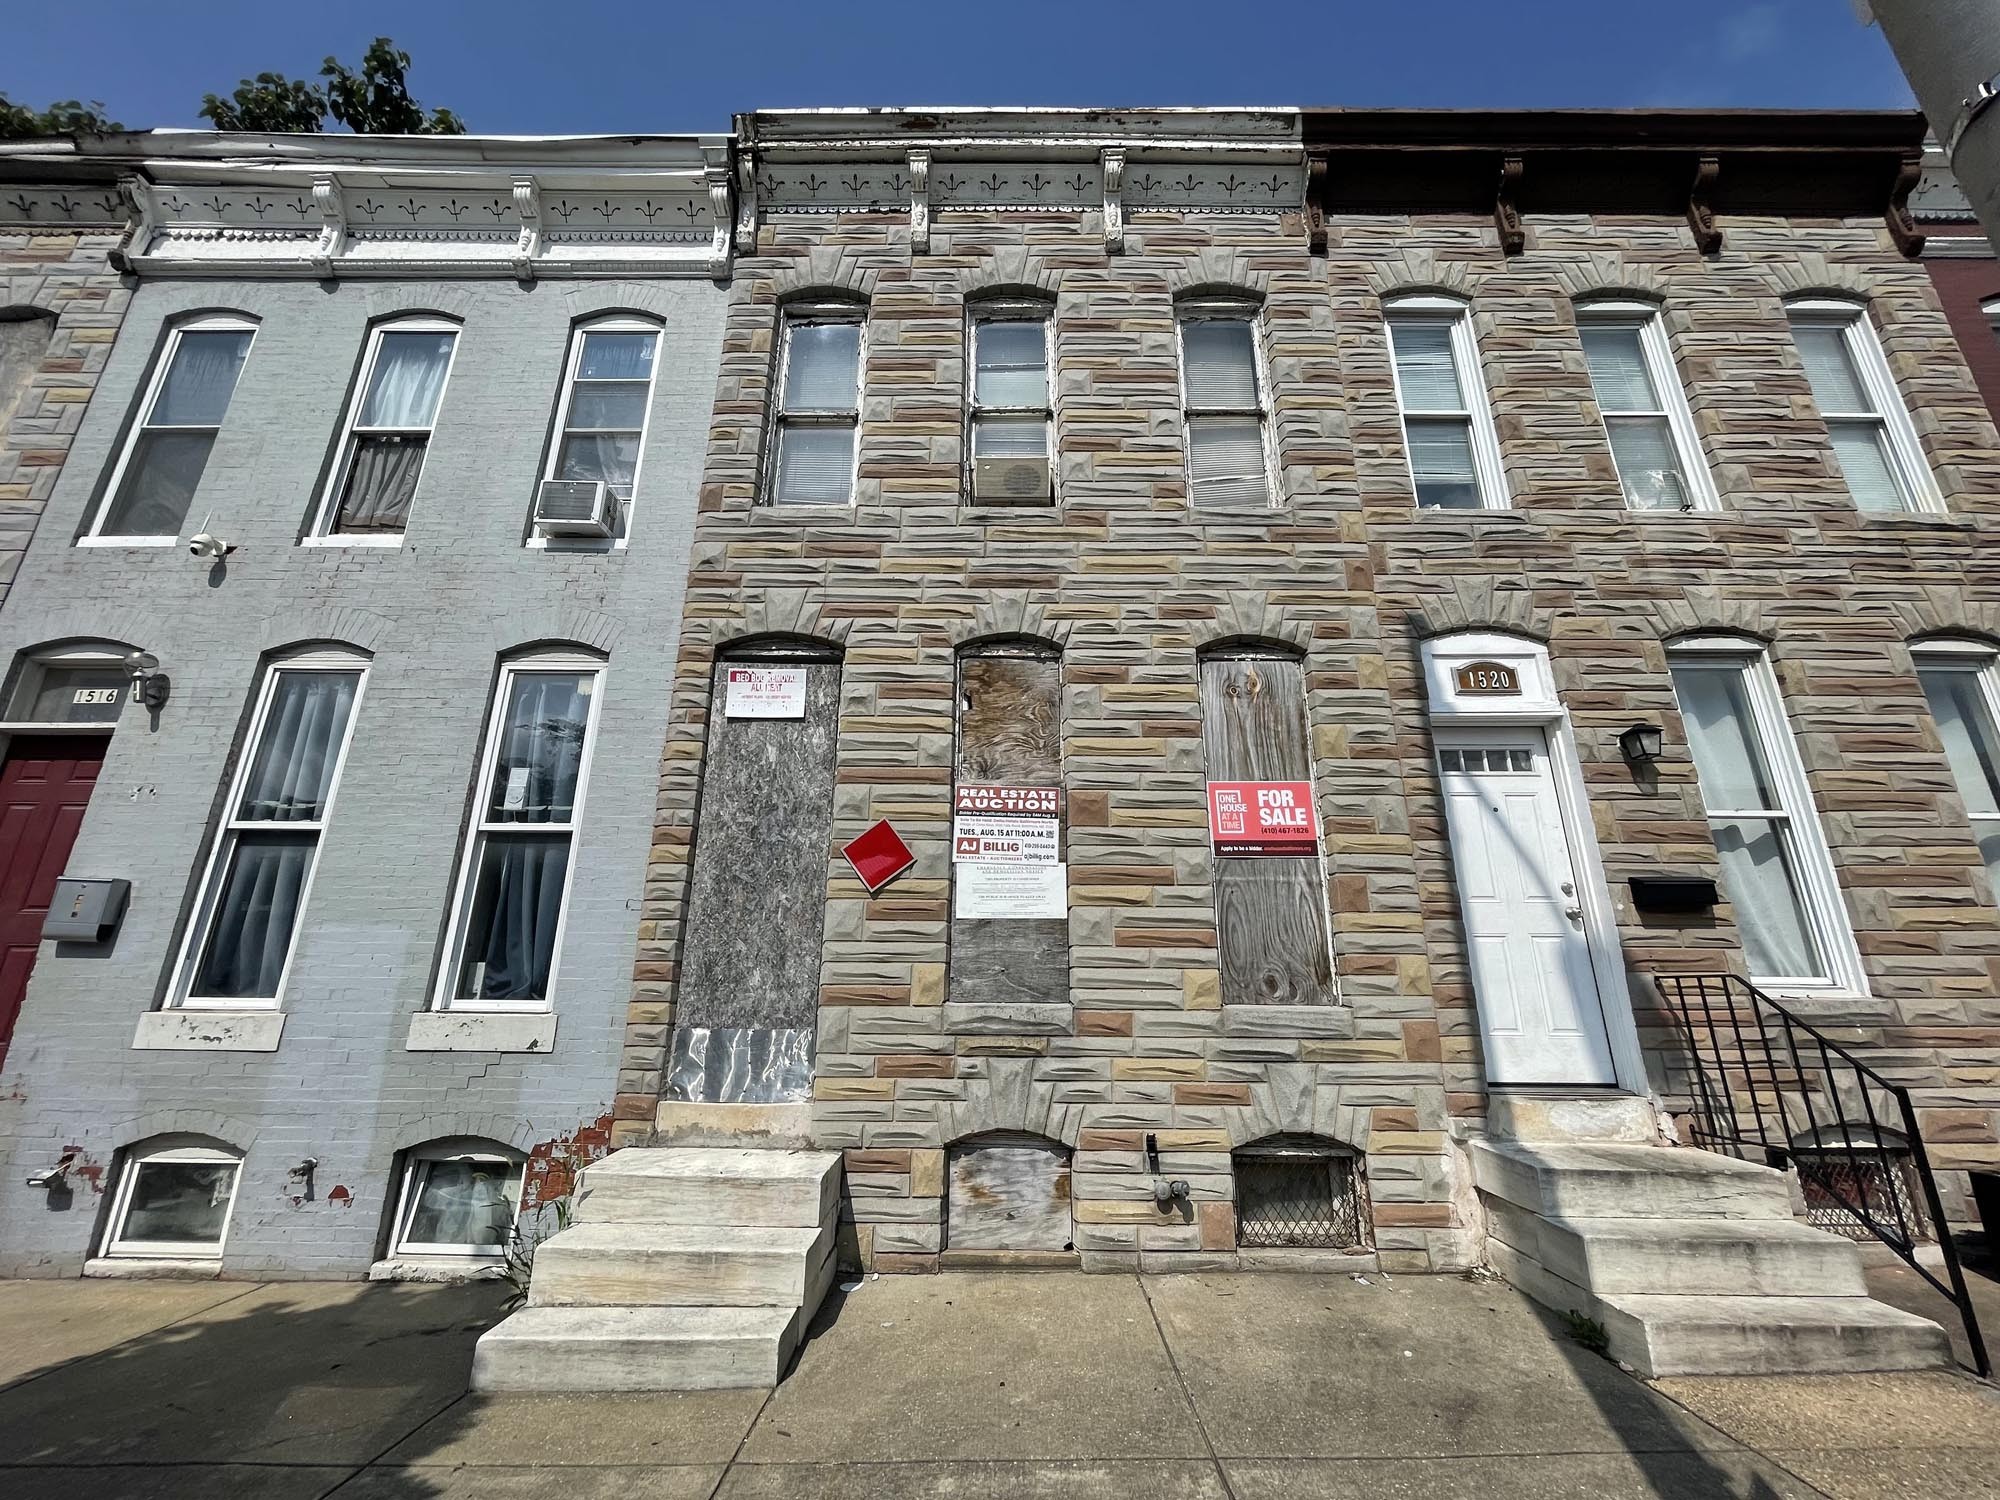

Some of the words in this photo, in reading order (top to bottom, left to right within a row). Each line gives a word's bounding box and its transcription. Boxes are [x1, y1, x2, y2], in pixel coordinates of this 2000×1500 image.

[736, 673, 750, 682] BED
[768, 673, 797, 683] REMOVA
[1469, 671, 1509, 688] 1520
[76, 690, 115, 702] 1516
[959, 788, 997, 798] REAL
[1000, 789, 1057, 799] ESTATE
[1219, 794, 1237, 803] ONE
[1257, 789, 1294, 807] FOR
[958, 798, 1056, 810] AUCTION
[1220, 803, 1248, 813] HOUSE
[1221, 812, 1231, 820] AT
[1232, 812, 1238, 820] A
[1259, 808, 1308, 826] SALE
[1222, 821, 1240, 829] TIME
[959, 828, 979, 837] TUES.,
[980, 829, 997, 837] AUG.
[997, 829, 1005, 837] 15
[960, 840, 977, 851] AJ
[983, 842, 1020, 852] BILLIG
